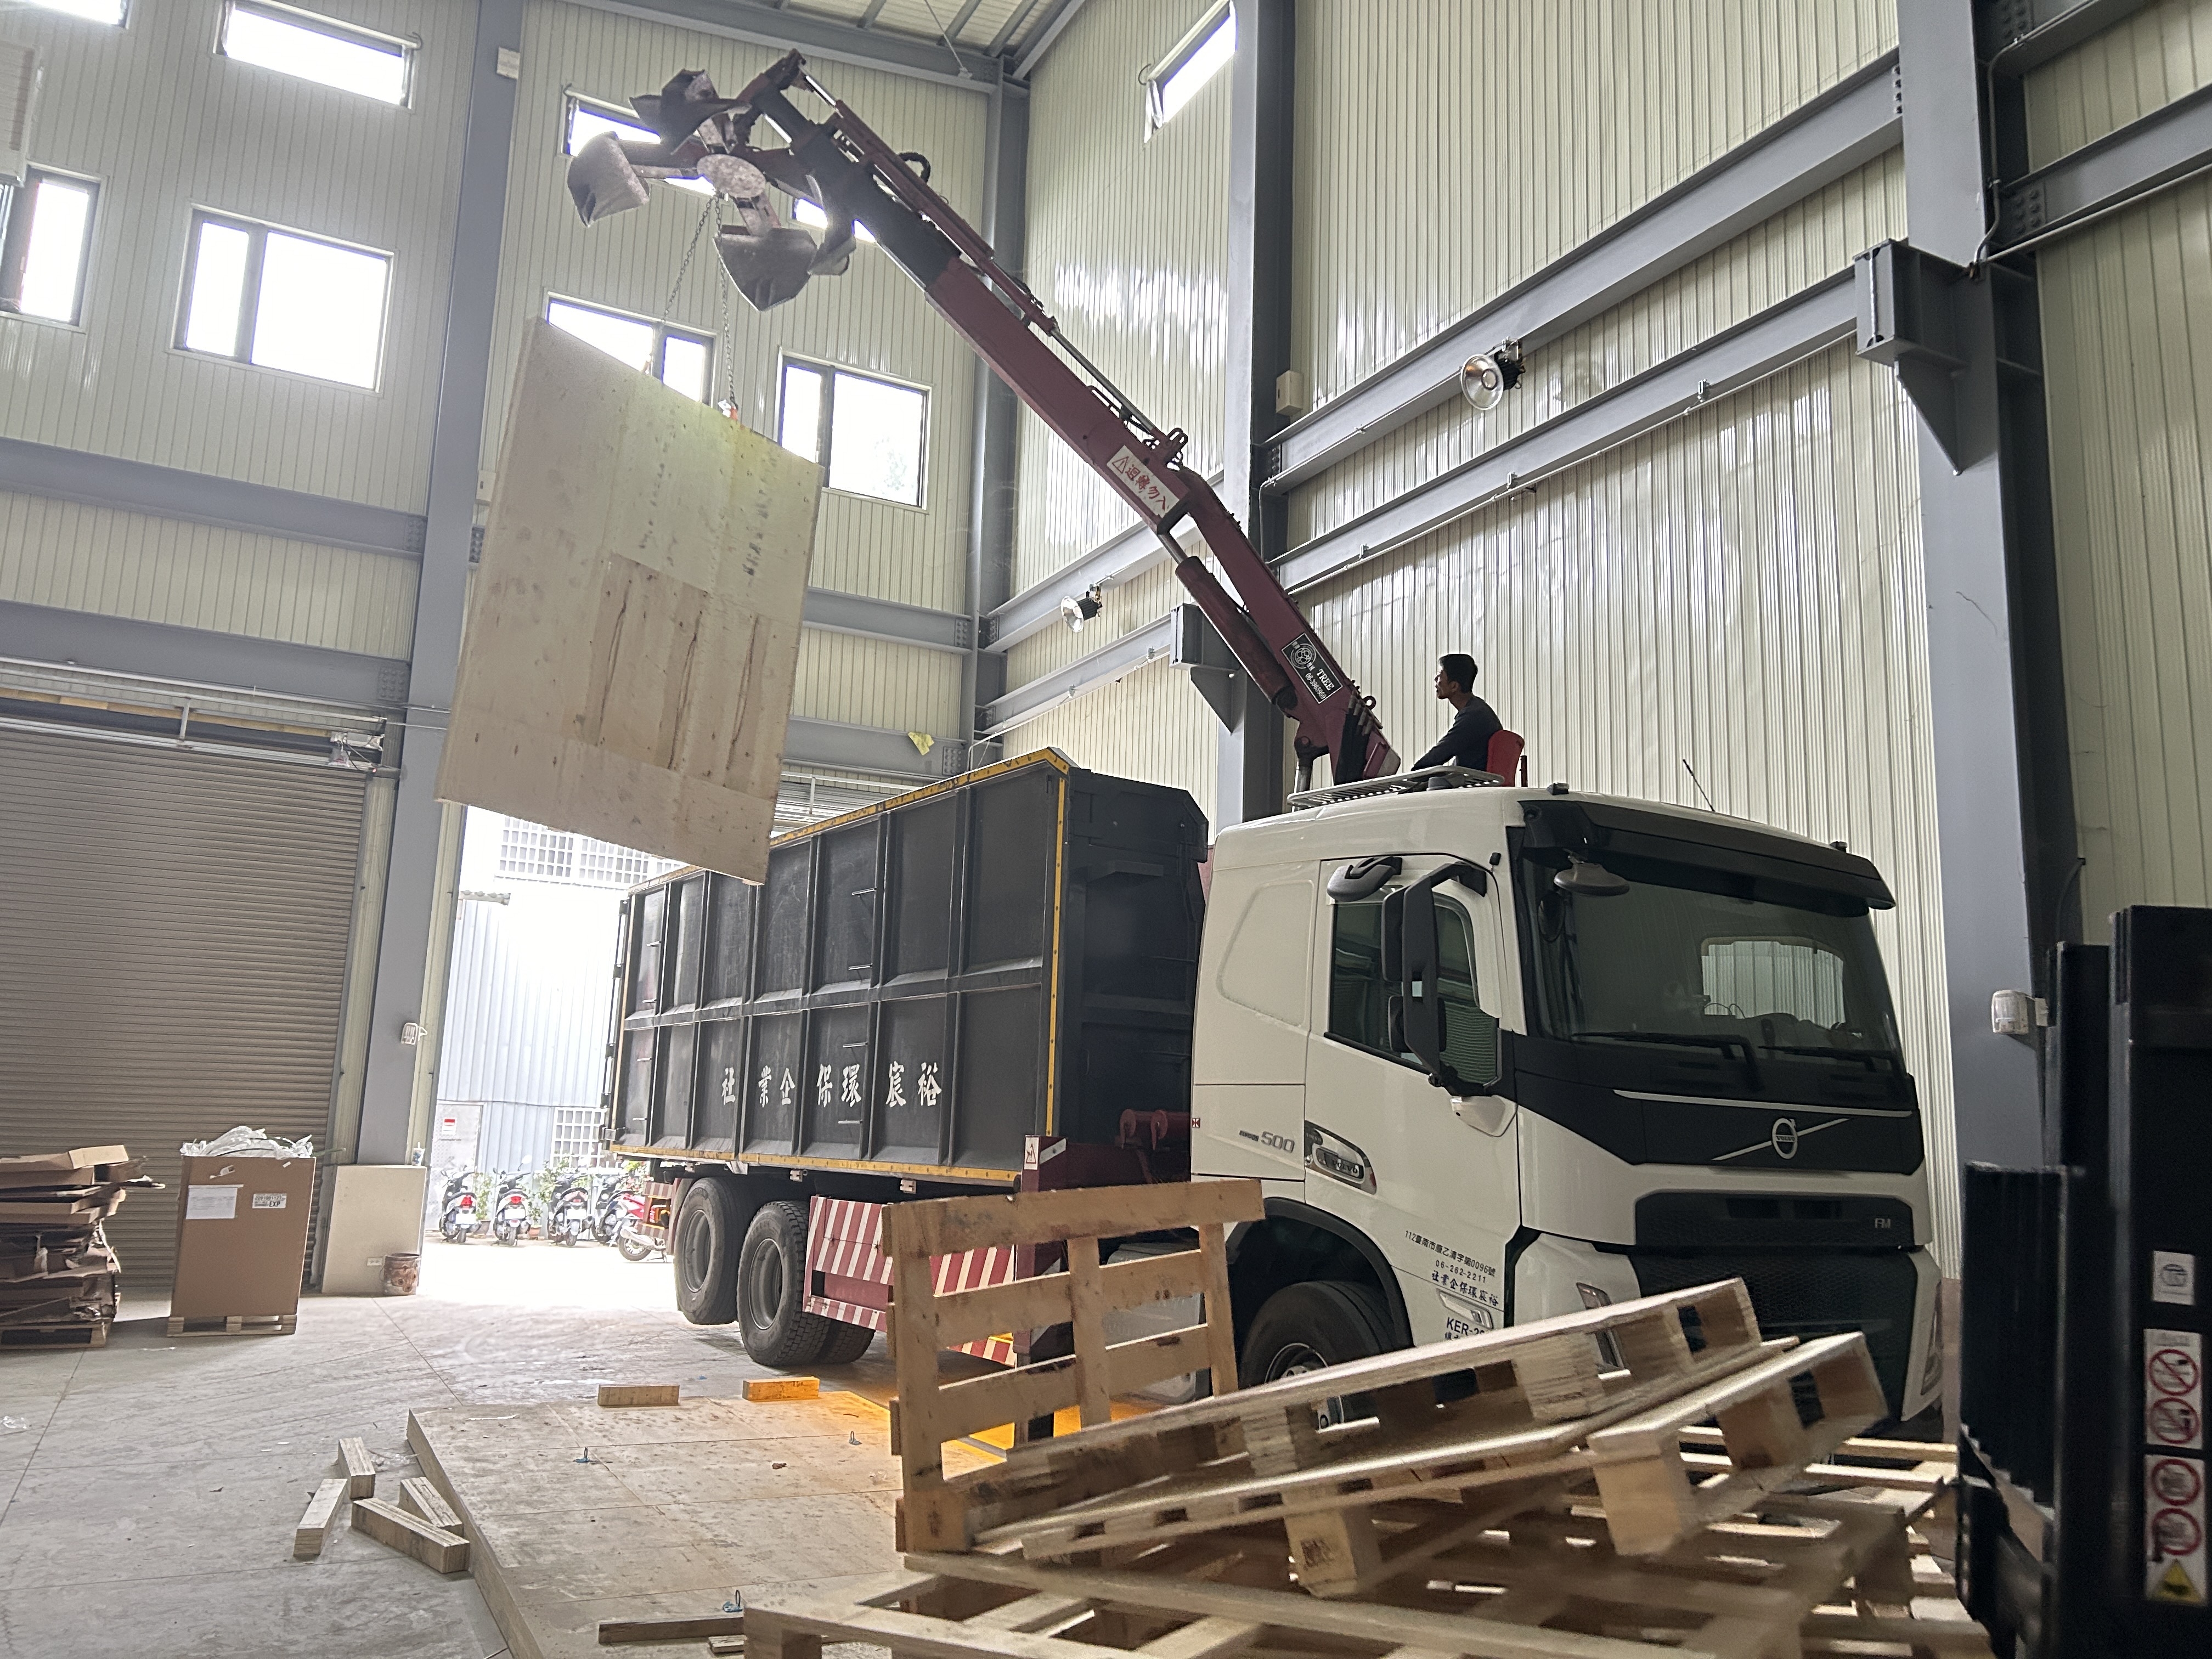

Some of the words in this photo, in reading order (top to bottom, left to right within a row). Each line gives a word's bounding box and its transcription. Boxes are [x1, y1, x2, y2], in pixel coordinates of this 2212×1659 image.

[1317, 669, 1334, 691] TREE
[1261, 1131, 1295, 1153] 500
[1875, 1217, 1891, 1229] FM
[1435, 1259, 1487, 1284] 06-262-2211
